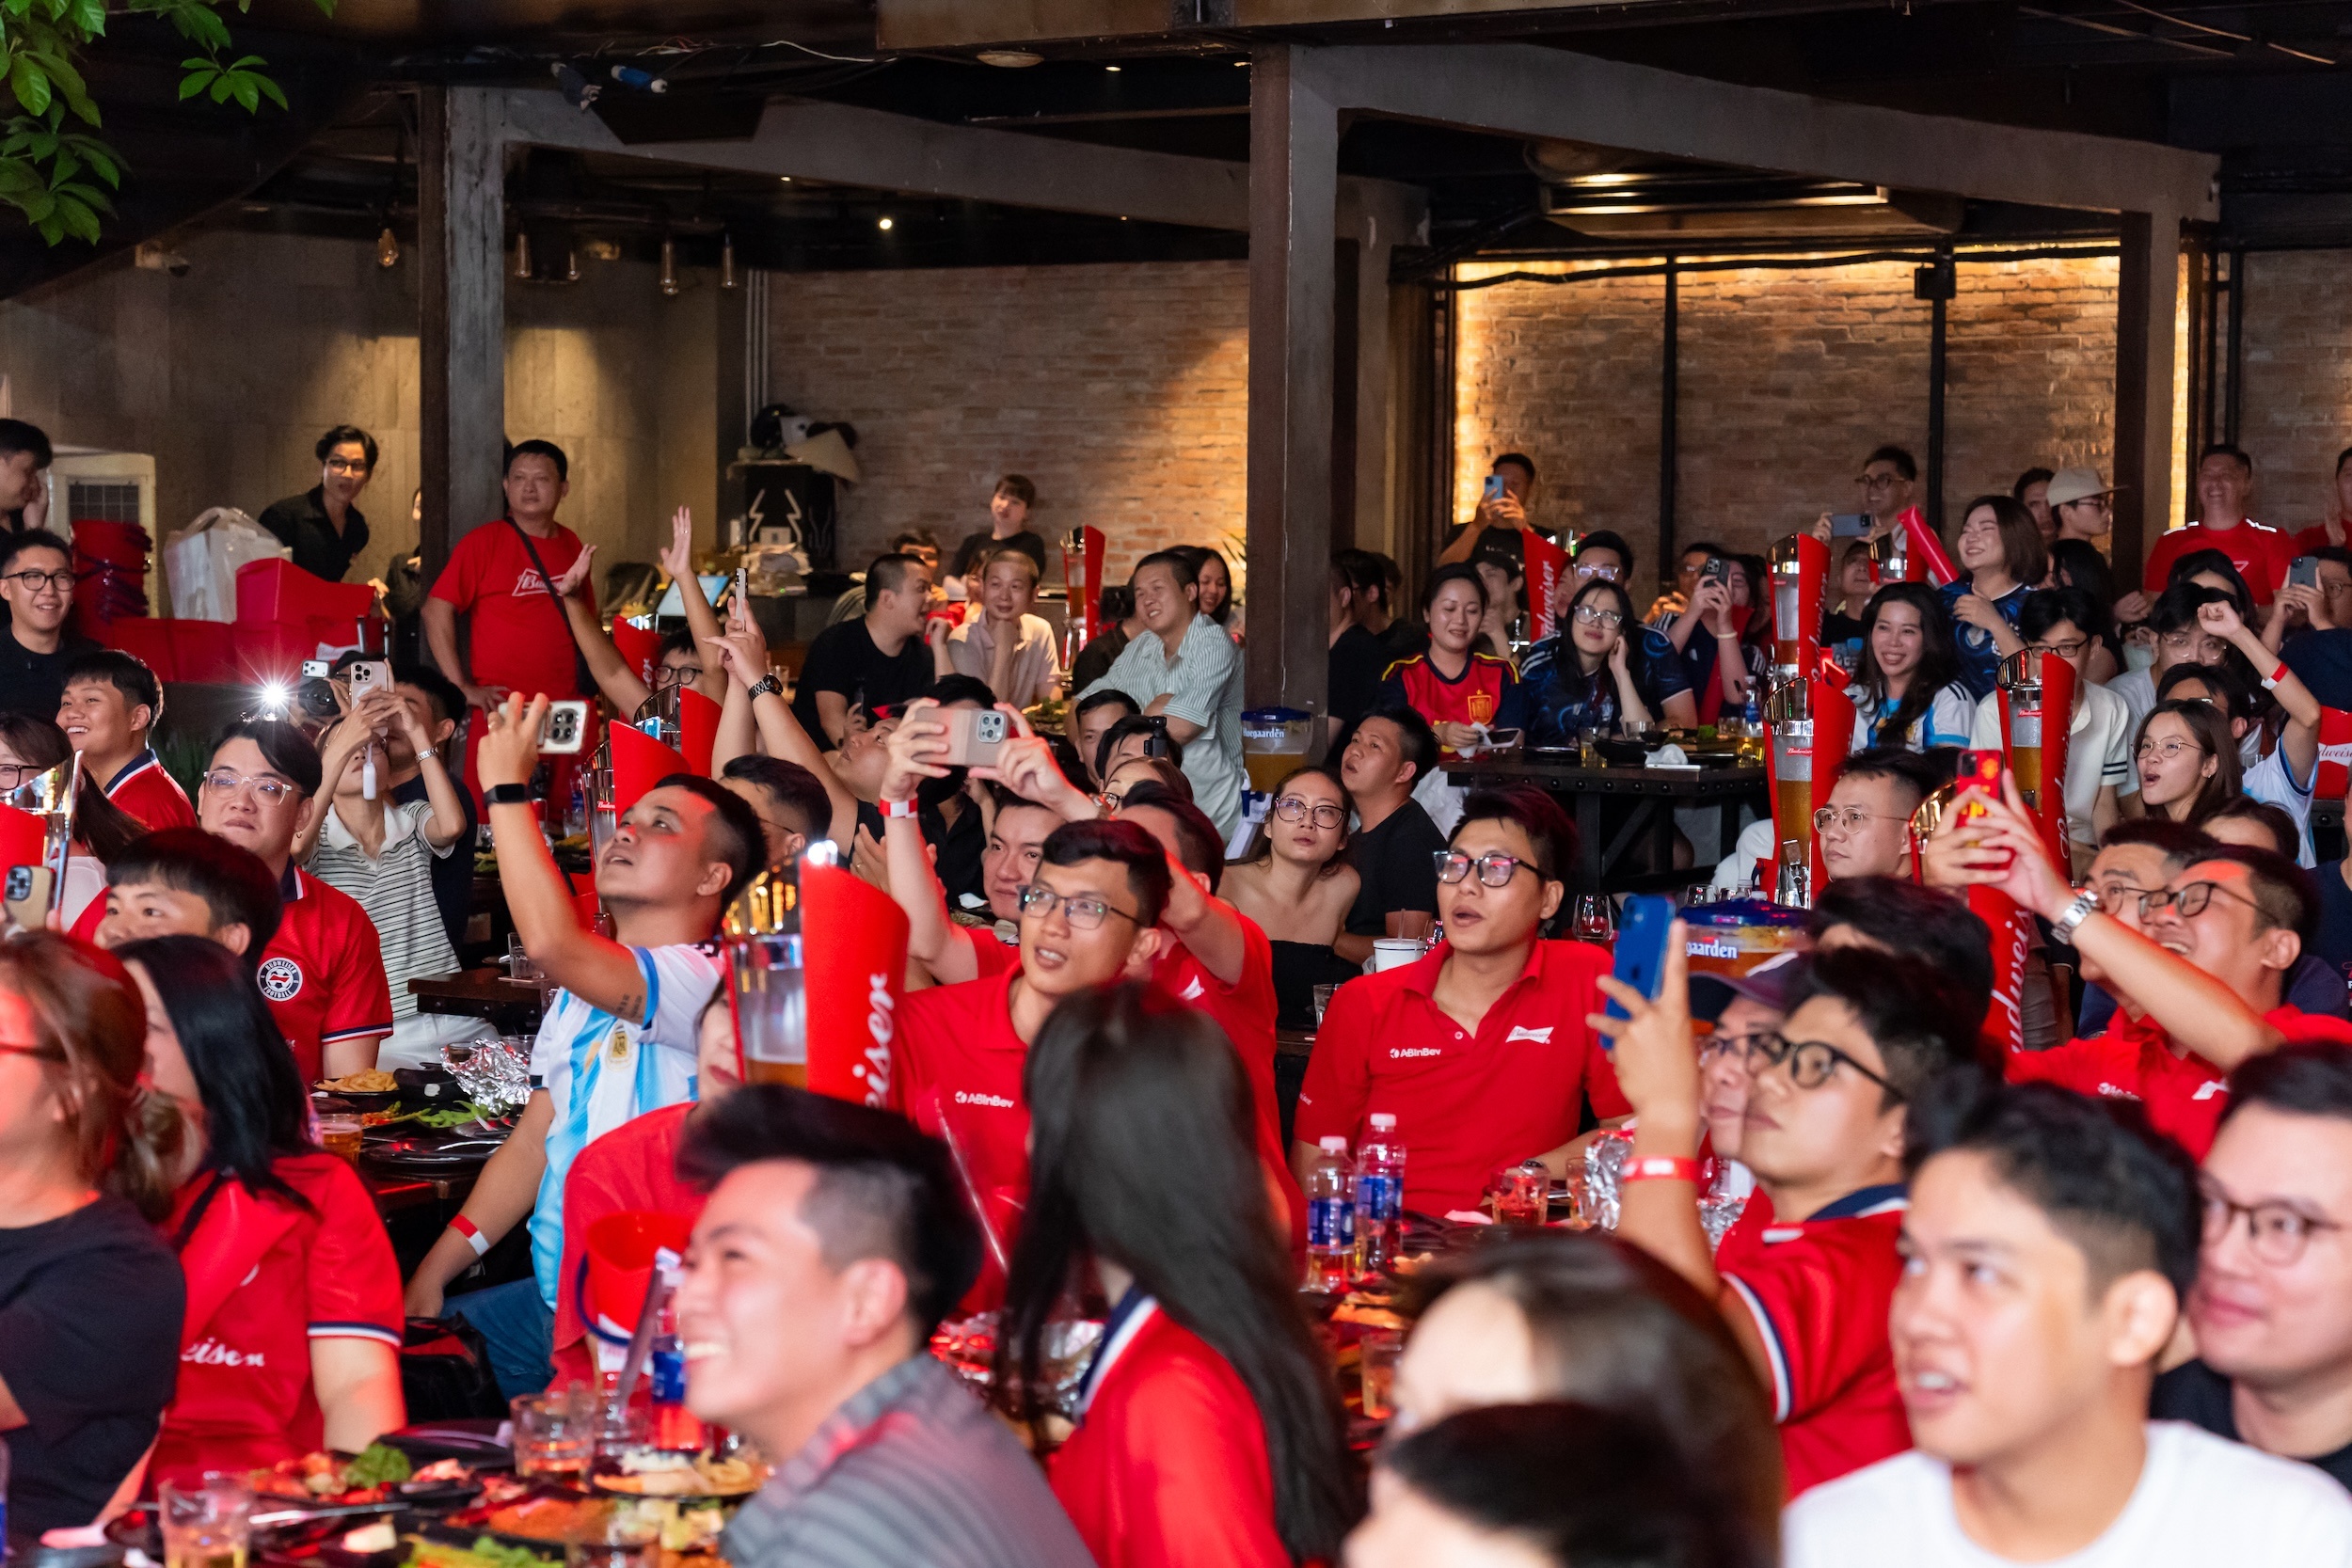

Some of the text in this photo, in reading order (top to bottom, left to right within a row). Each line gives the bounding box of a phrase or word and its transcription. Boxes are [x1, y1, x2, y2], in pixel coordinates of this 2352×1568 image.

[1686, 939, 1739, 958] gaarden
[1400, 1048, 1441, 1058] ABInBev
[967, 1093, 1015, 1108] ABInBev
